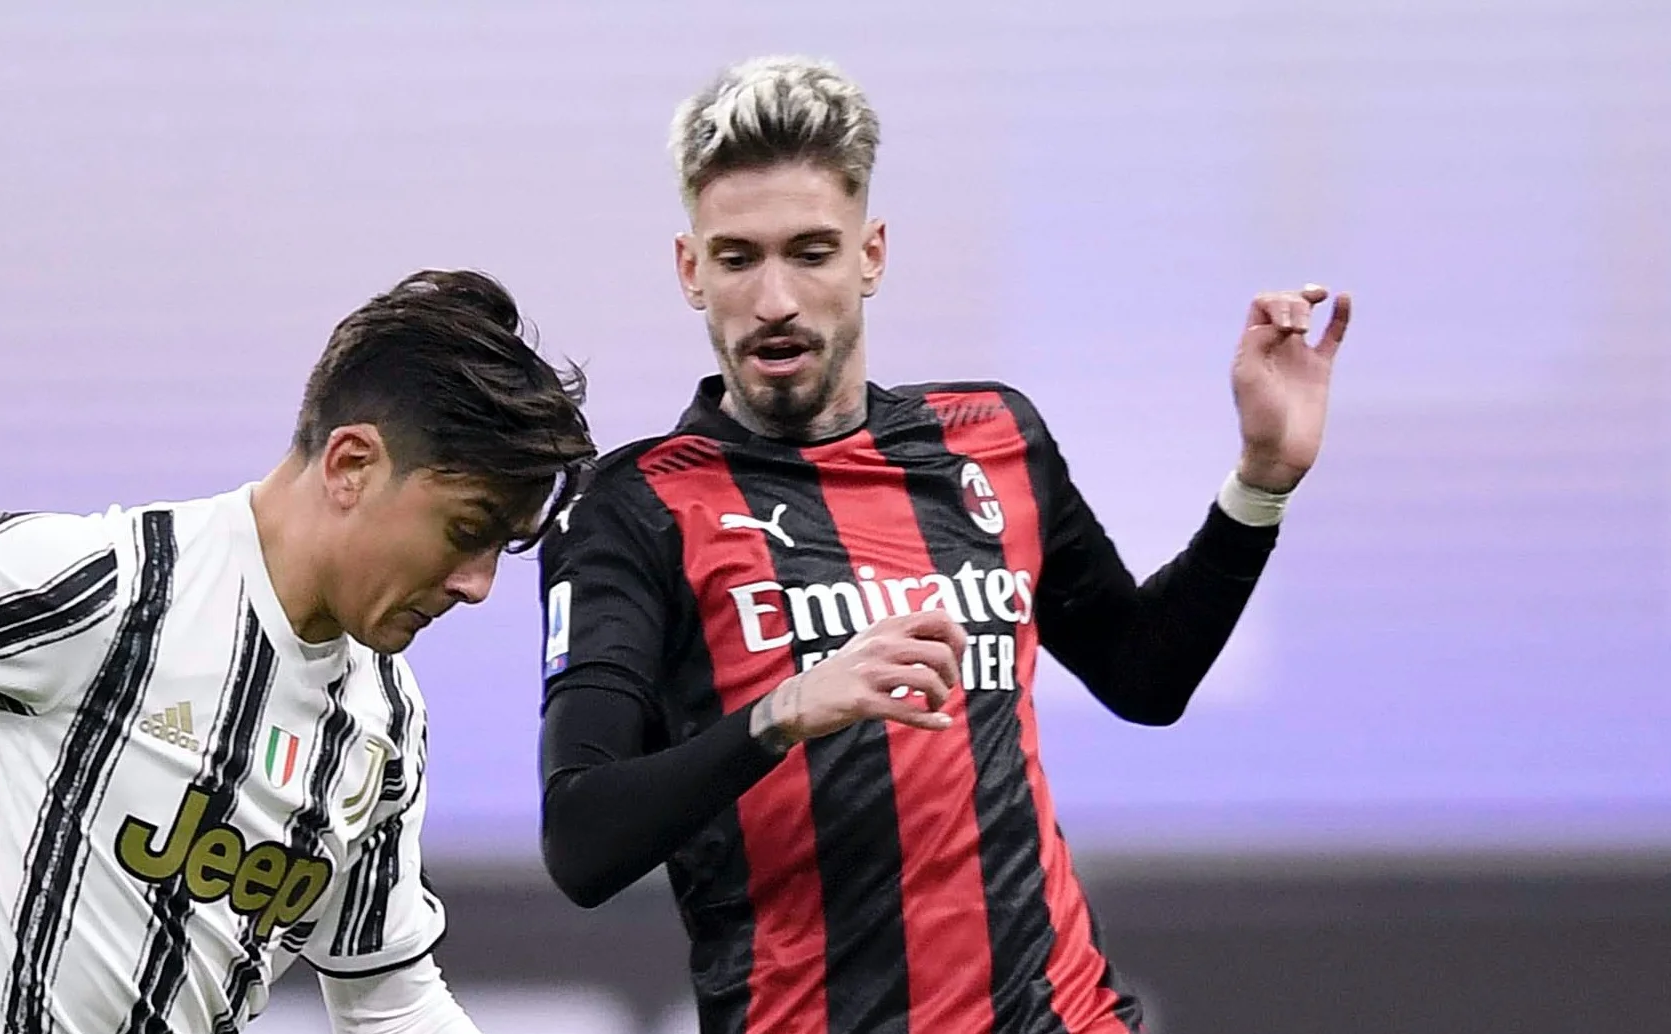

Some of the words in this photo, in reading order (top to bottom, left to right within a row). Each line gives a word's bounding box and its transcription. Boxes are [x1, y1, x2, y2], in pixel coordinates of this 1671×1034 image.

[728, 561, 1032, 653] Emirates
[139, 719, 199, 752] adidas
[116, 785, 332, 941] Jeep
